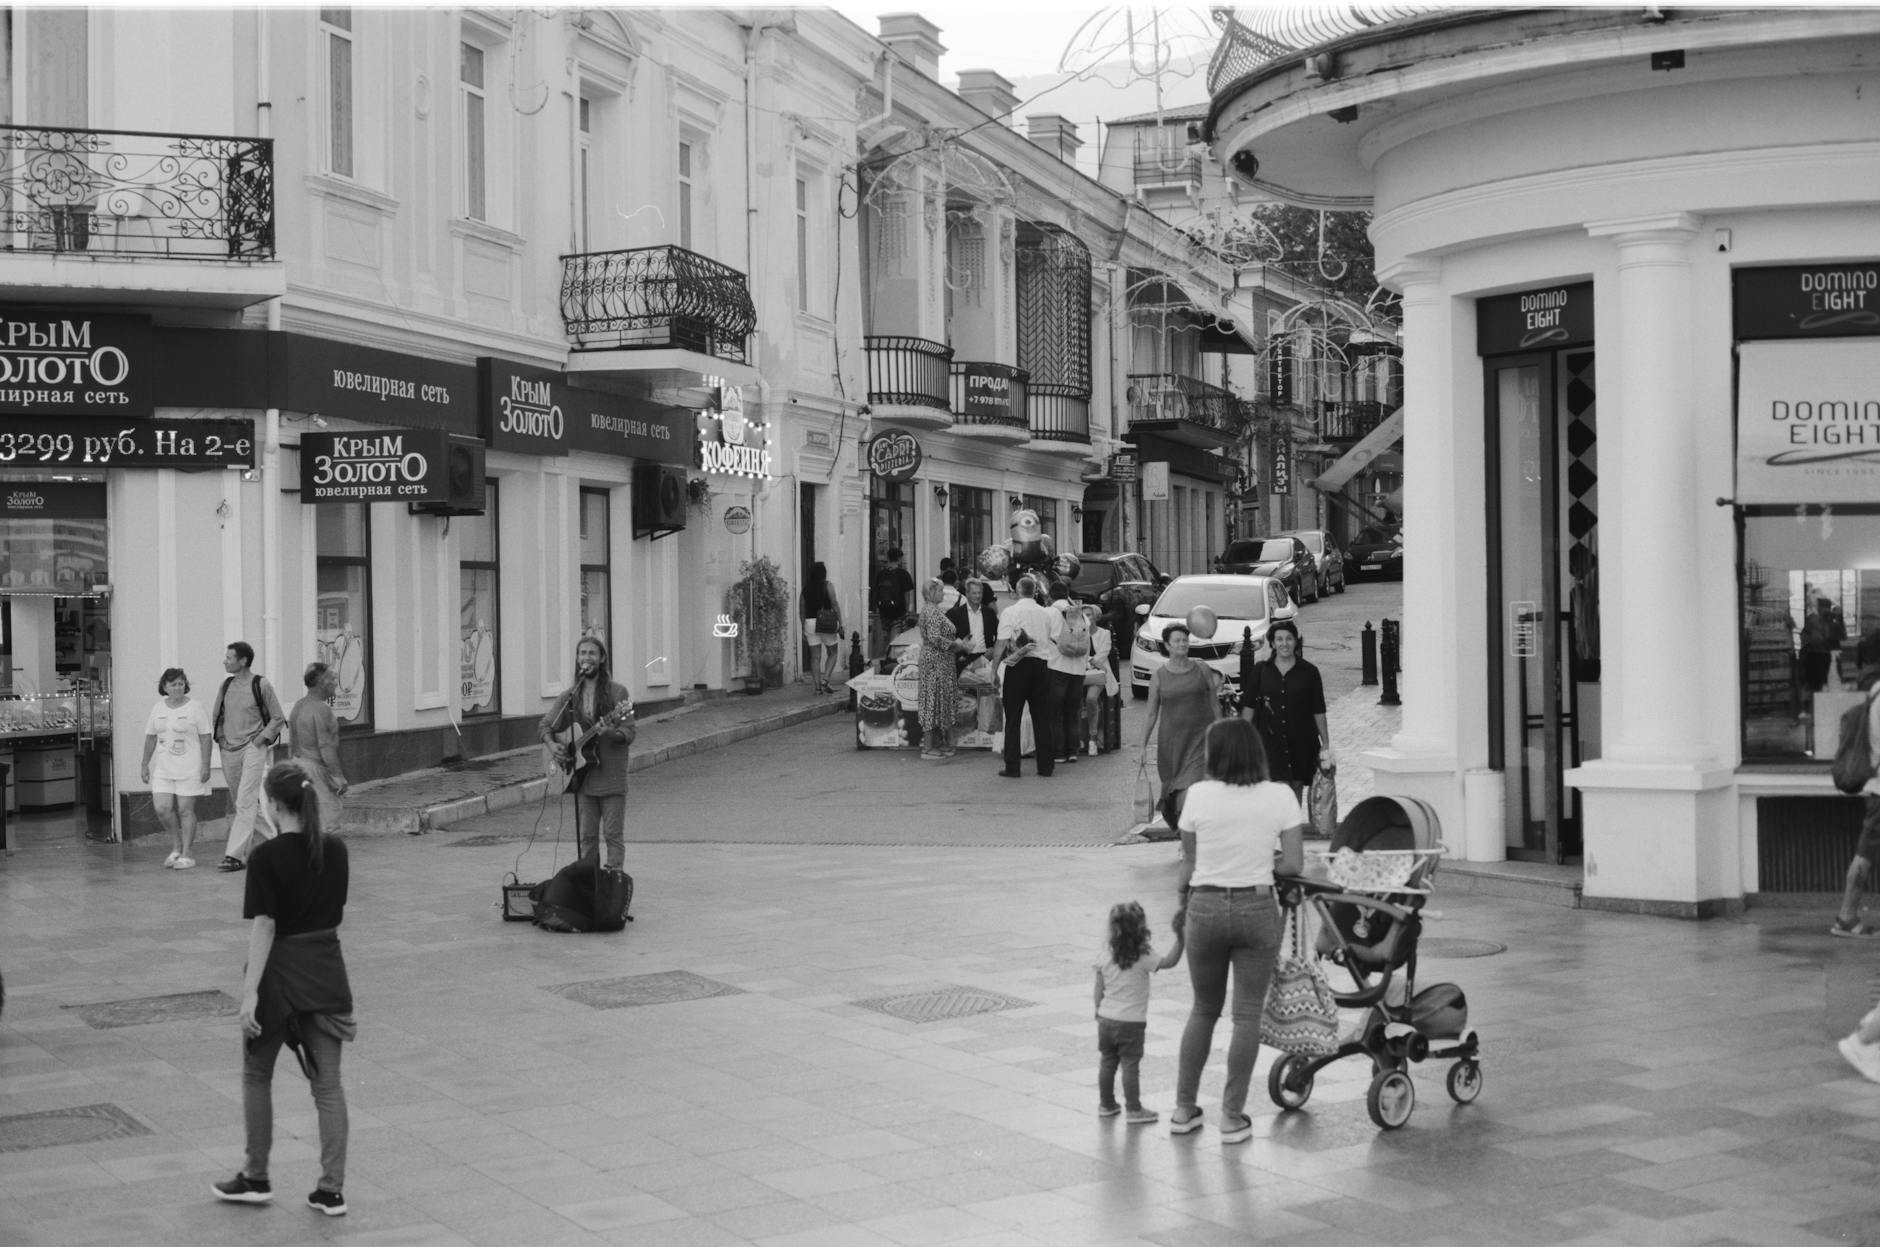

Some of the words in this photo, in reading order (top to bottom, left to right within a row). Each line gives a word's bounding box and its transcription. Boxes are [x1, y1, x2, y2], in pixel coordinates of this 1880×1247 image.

[1801, 271, 1878, 291] DOMINO
[1520, 290, 1567, 312] DOMINO
[1812, 290, 1867, 311] EIGHT
[1527, 308, 1561, 329] EIGHT
[0, 318, 92, 348] РЫМ
[84, 391, 129, 404] сеть
[333, 369, 415, 401] ювелирная
[421, 384, 450, 404] сеть
[591, 413, 647, 438] ювелирная
[650, 424, 670, 440] сеть
[1790, 423, 1880, 445] EIGHT
[0, 433, 74, 461] 3299
[83, 428, 144, 462] руб.
[155, 430, 197, 456] На
[877, 440, 910, 462] CAPRI
[315, 485, 392, 499] ювелирная
[398, 484, 428, 495] сеть
